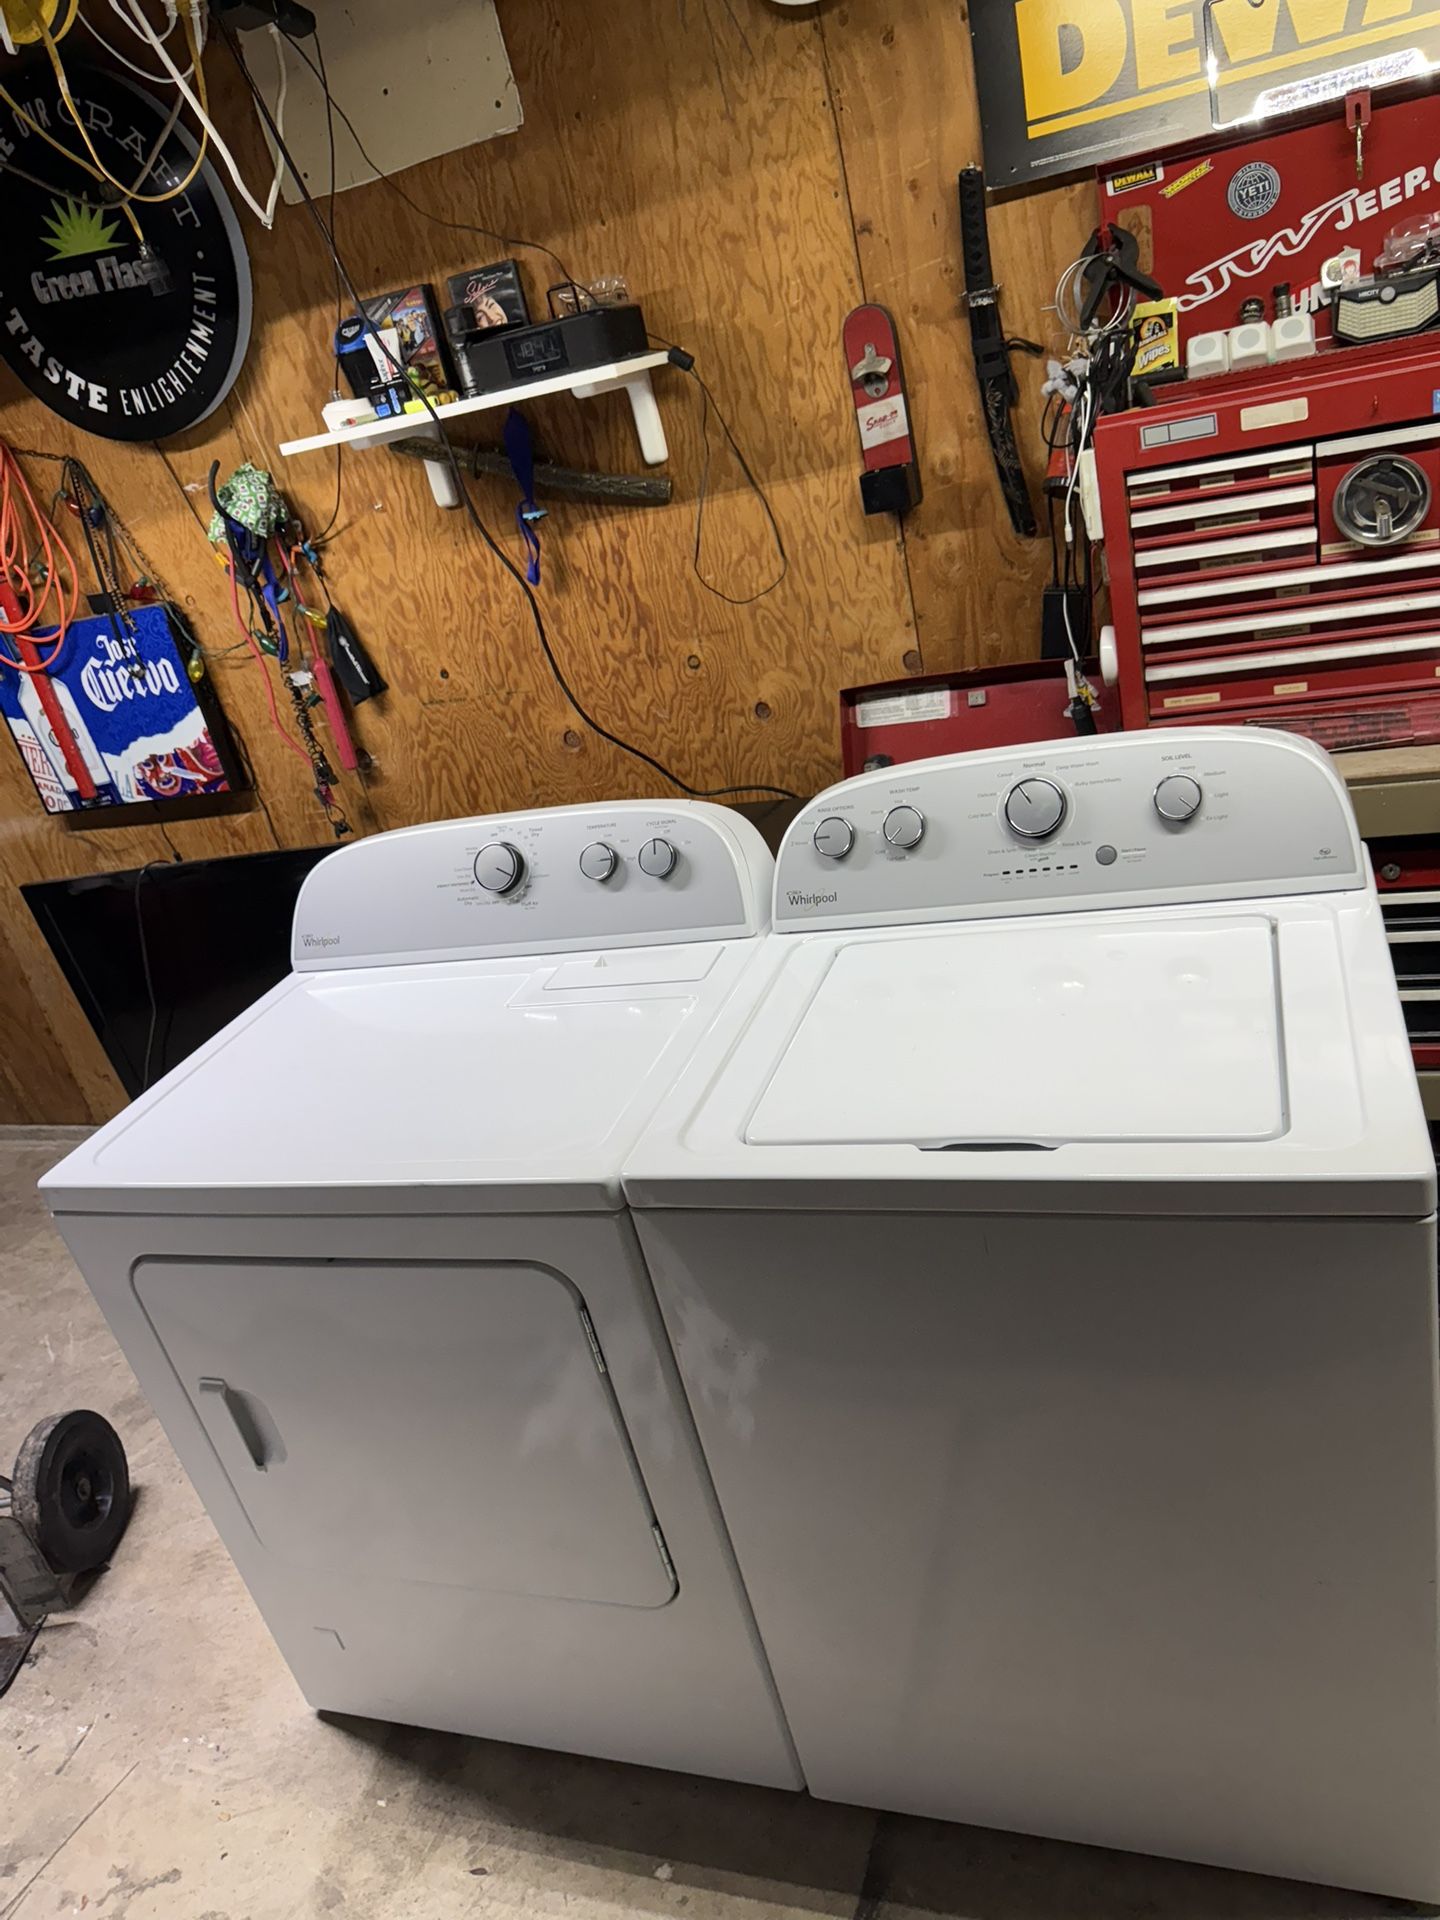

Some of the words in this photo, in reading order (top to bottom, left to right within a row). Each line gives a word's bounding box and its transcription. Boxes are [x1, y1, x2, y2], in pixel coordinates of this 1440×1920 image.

[1015, 0, 1413, 121] DEW
[1113, 169, 1154, 188] DEWALT
[1239, 180, 1270, 199] YETI
[30, 264, 100, 305] Green
[96, 255, 152, 292] Flas
[5, 307, 109, 413] TASTE
[119, 272, 217, 416] ENLIGHTENMENT
[1139, 343, 1171, 369] Wipes
[80, 656, 180, 712] Cuervo
[789, 891, 837, 906] Whirlpool
[301, 935, 340, 948] Whirlpool
